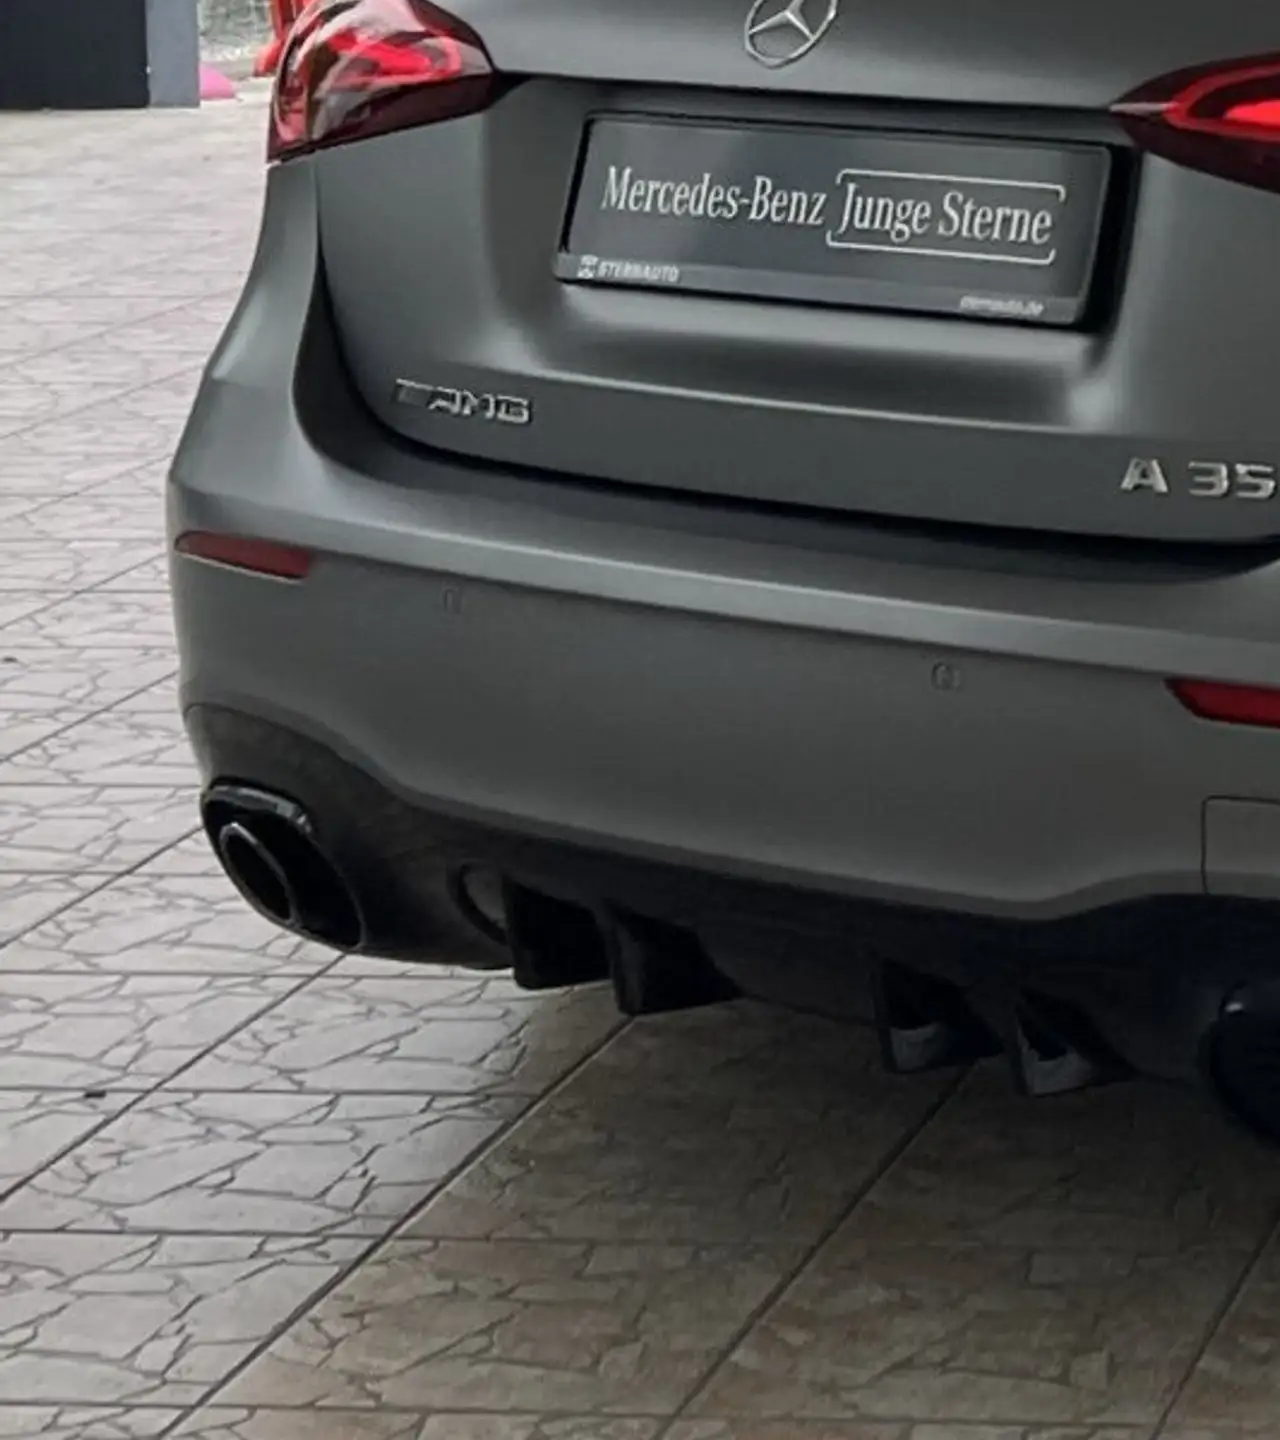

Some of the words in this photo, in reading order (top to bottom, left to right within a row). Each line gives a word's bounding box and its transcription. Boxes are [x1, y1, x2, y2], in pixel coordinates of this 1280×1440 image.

[601, 165, 827, 226] Mercedes-Benz
[837, 182, 931, 243] Junge
[937, 190, 1052, 244] Sterne
[426, 386, 530, 424] AMG
[1120, 457, 1168, 493] A
[1188, 461, 1276, 499] 35
